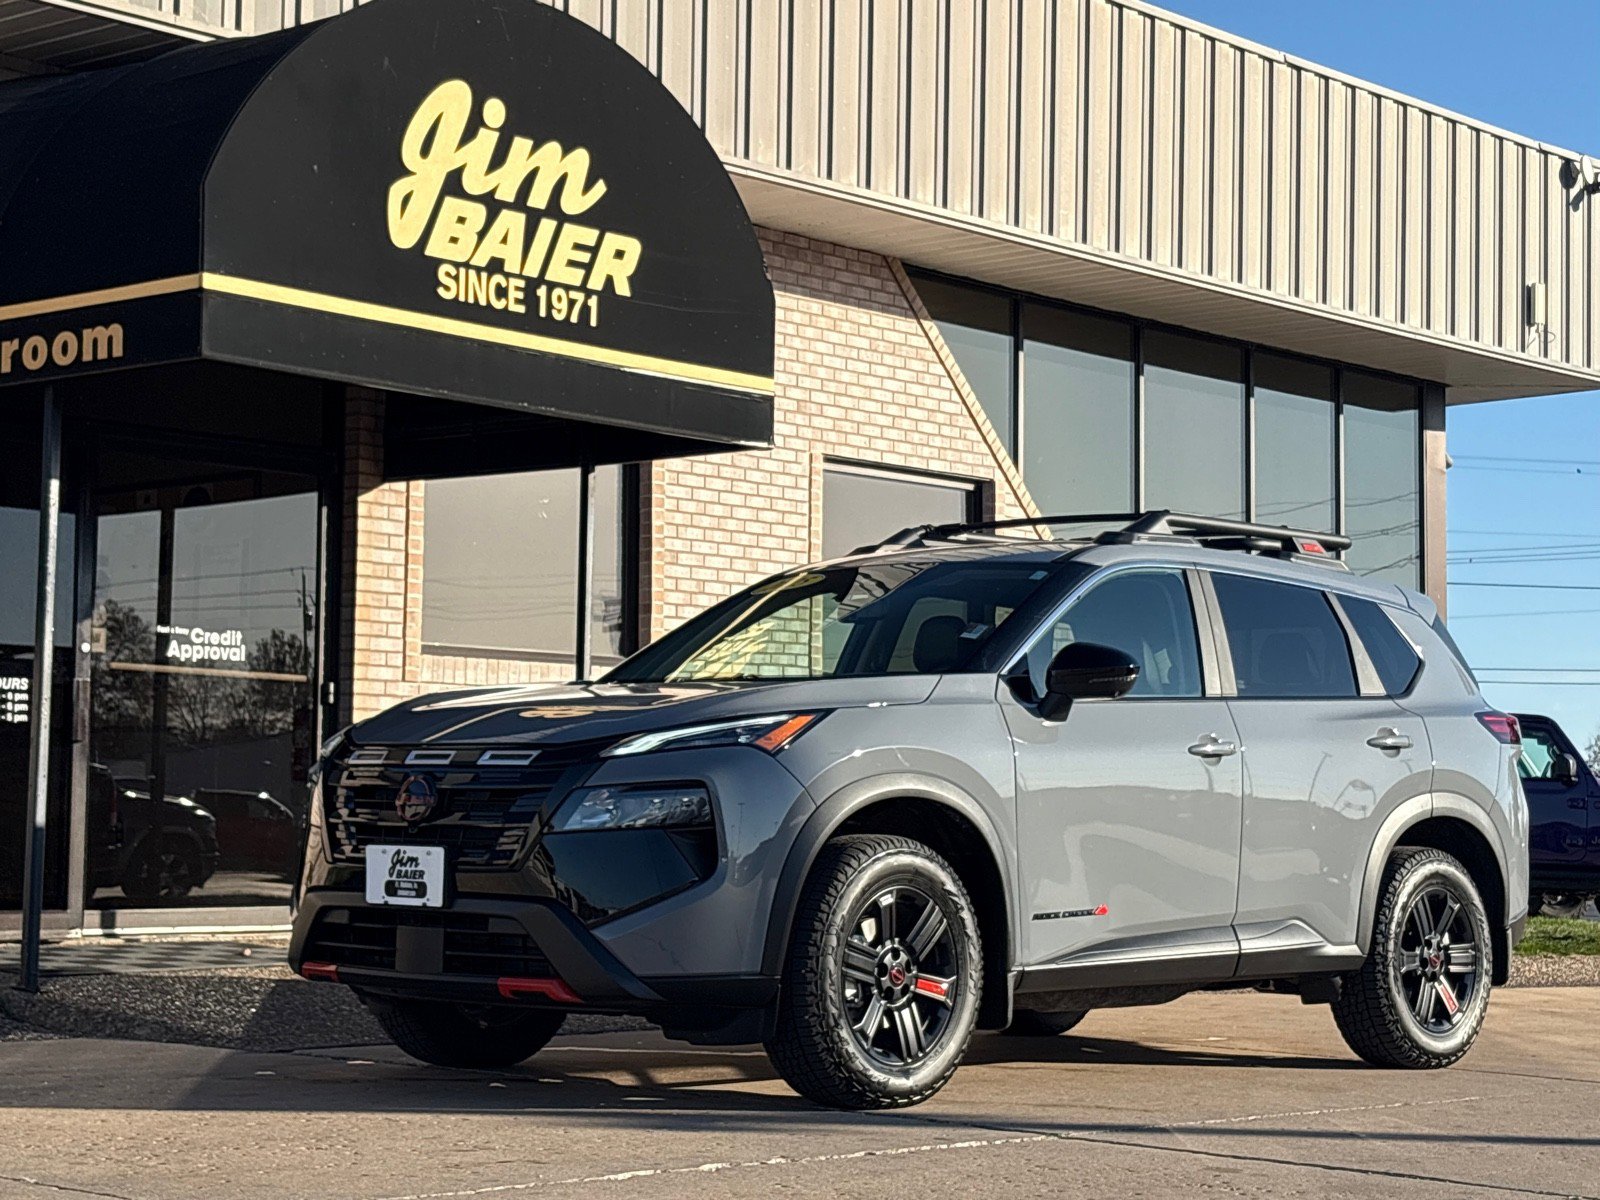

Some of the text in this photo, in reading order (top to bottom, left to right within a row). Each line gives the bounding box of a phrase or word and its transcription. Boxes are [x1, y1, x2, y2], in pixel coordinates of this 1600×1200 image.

[387, 78, 608, 250] Jim
[424, 195, 642, 298] BAIER
[436, 263, 599, 328] SINCE 1971
[0, 323, 124, 374] room
[190, 627, 243, 647] Credit
[166, 640, 246, 663] Approval
[0, 677, 29, 690] URS
[14, 692, 29, 702] pm
[14, 703, 29, 713] pm
[14, 714, 28, 724] pm
[388, 848, 420, 878] Jim
[395, 869, 425, 880] BAIER
